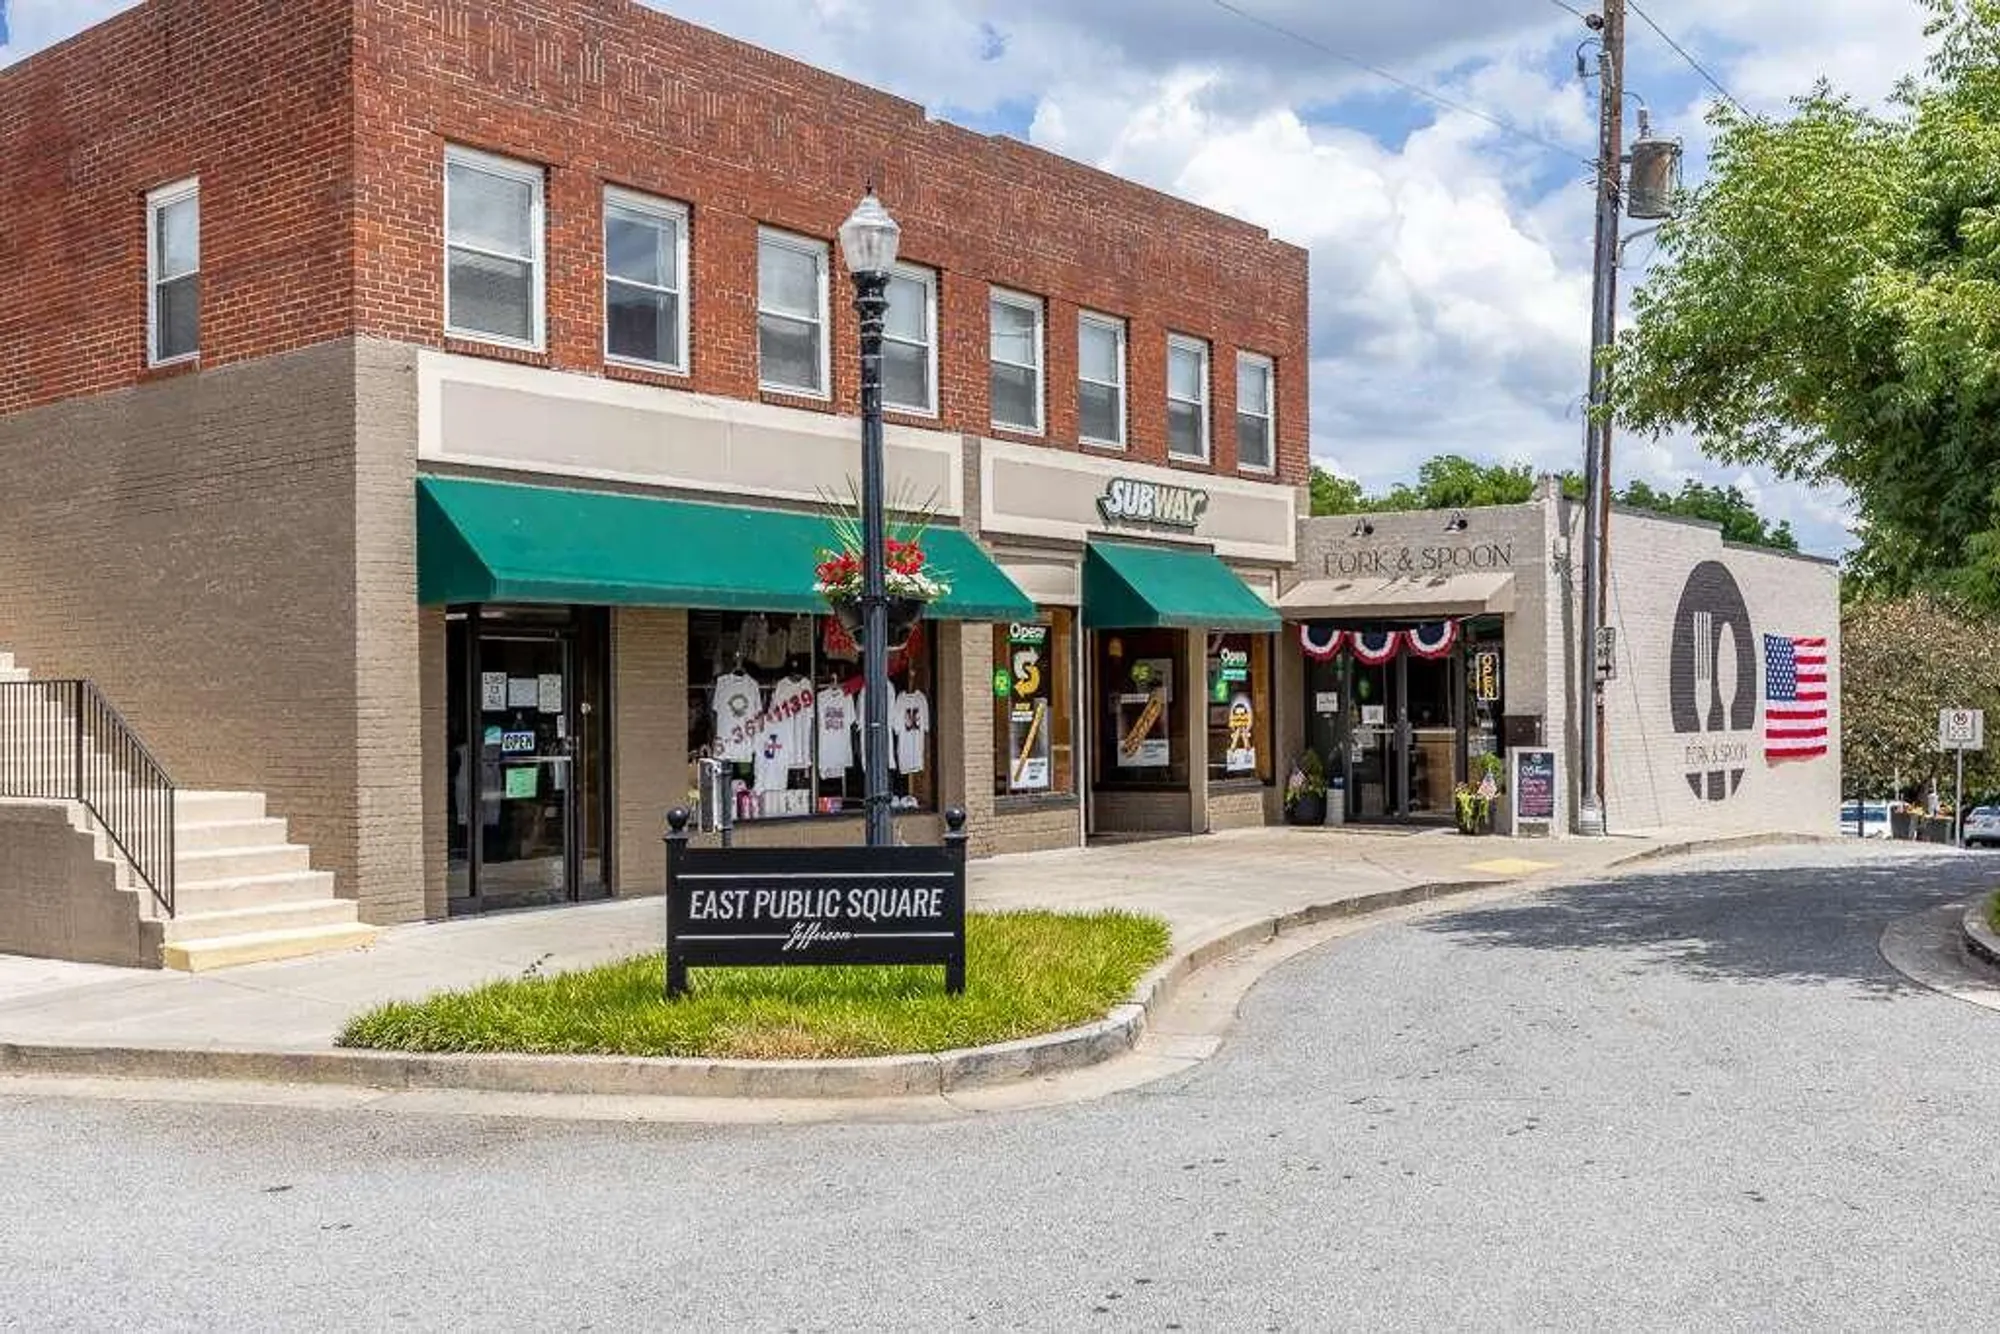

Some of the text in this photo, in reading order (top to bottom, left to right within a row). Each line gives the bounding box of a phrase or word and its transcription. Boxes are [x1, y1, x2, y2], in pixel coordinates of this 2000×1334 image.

[1102, 478, 1207, 523] SUBWAY
[1323, 542, 1512, 577] FORK & SPOON
[1010, 623, 1046, 641] Open
[1481, 655, 1494, 698] OPEN
[503, 733, 533, 749] OPEN
[688, 887, 945, 922] EAST PUBLIC SQUARE
[781, 921, 852, 951] Jefferson
